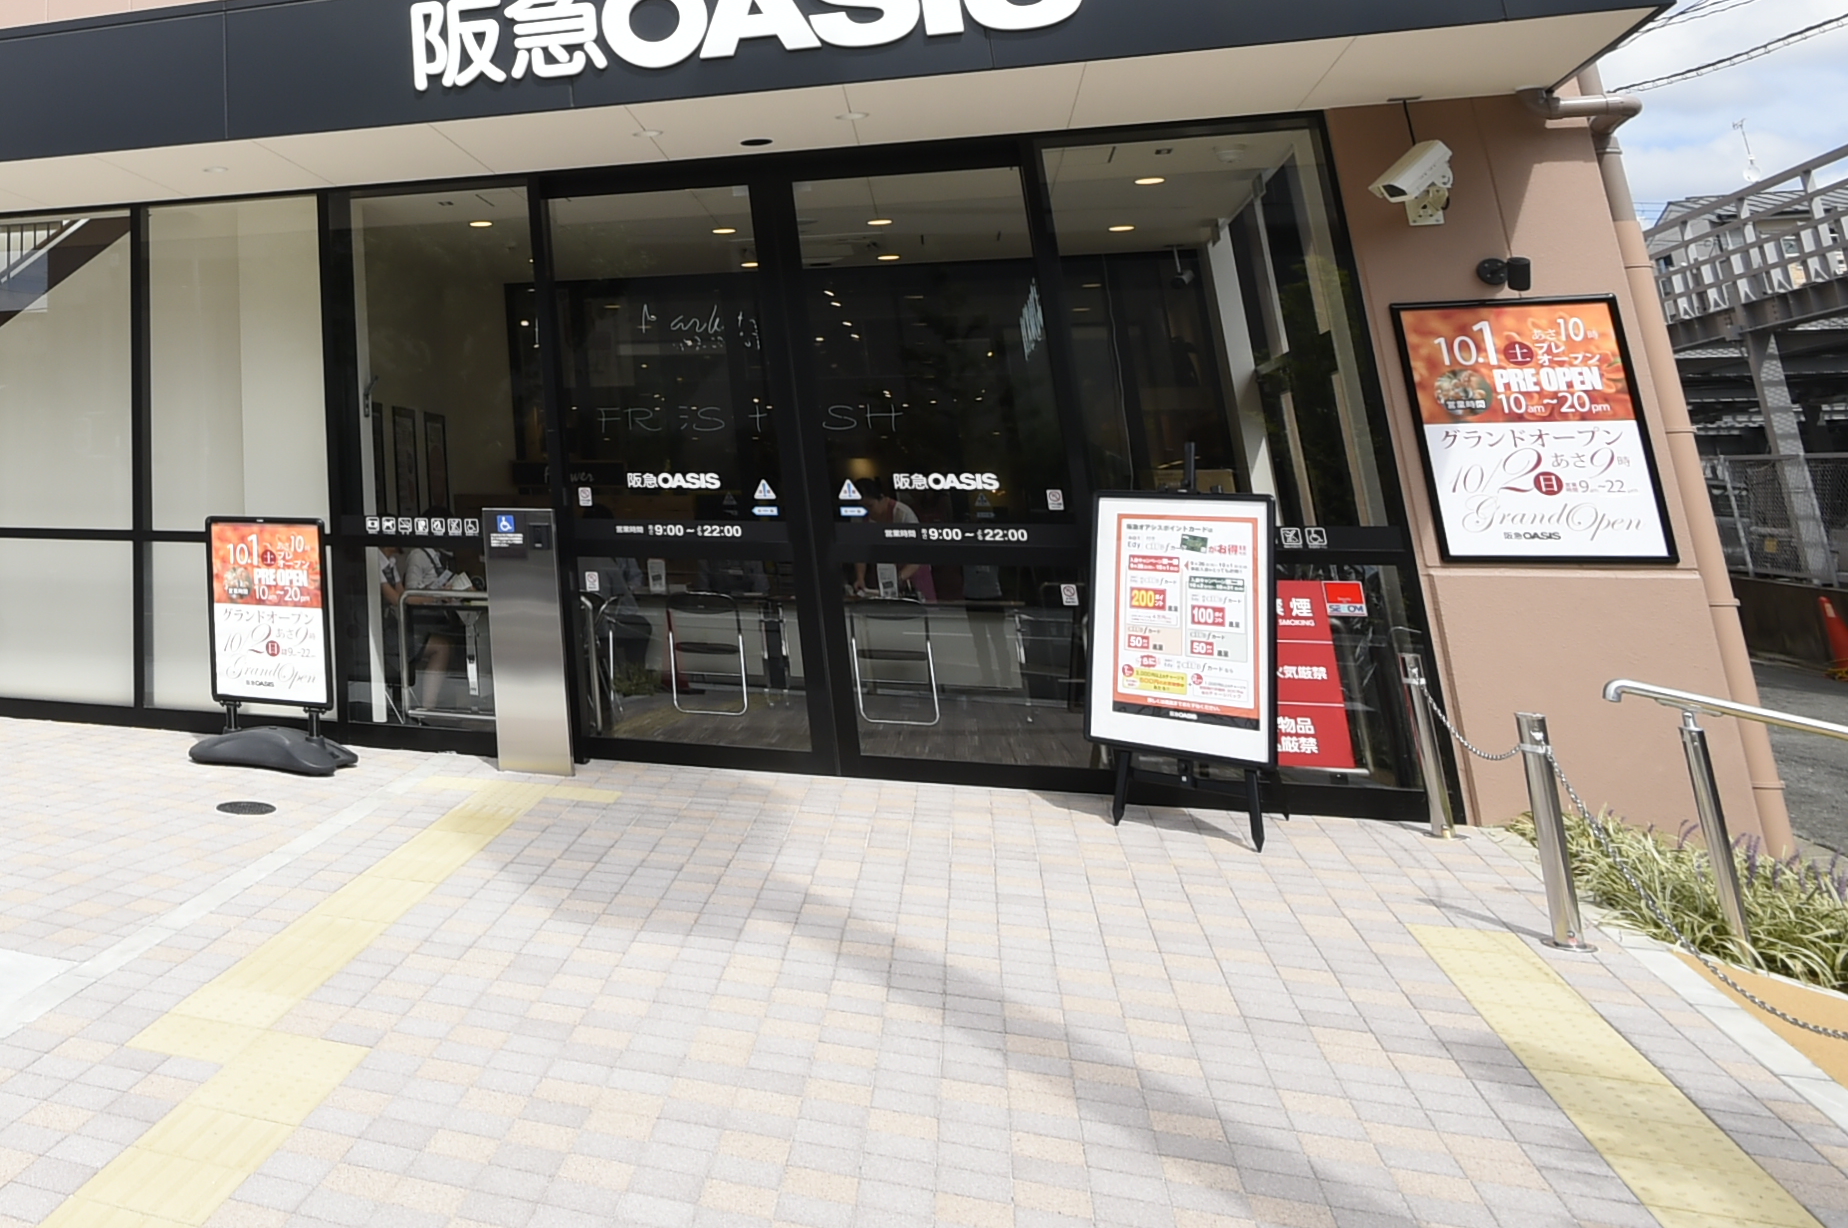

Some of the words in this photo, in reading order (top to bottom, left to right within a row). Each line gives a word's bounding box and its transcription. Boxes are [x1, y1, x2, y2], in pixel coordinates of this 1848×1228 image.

[1492, 368, 1540, 393] PRE
[1541, 366, 1603, 391] OPEN
[1440, 426, 1624, 450] グランドオープン
[626, 472, 721, 489] 阪急OASIS
[892, 472, 1000, 491] 阪急OASIS
[253, 568, 277, 586] PRE
[277, 569, 309, 587] OPEN
[1131, 589, 1155, 607] 200
[223, 609, 315, 626] グランドオープン
[1192, 606, 1214, 624] 100
[1278, 619, 1316, 627] SMOKING
[1129, 636, 1142, 647] 50
[1192, 642, 1207, 654] 50
[1277, 736, 1319, 754] 厳禁
